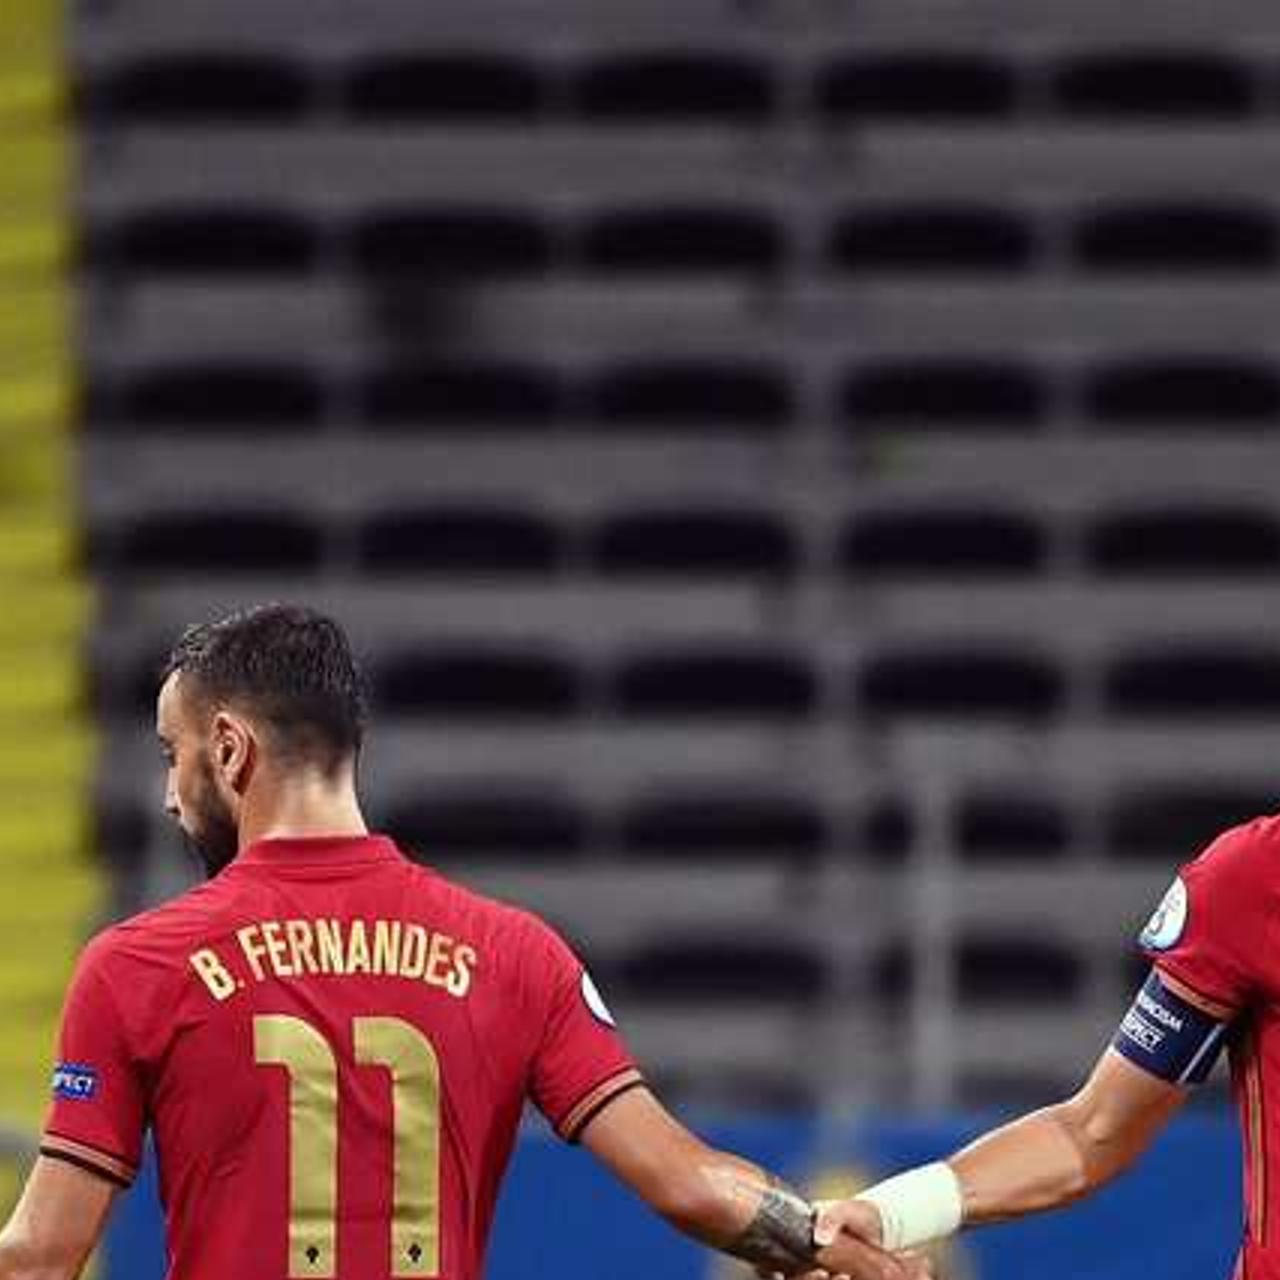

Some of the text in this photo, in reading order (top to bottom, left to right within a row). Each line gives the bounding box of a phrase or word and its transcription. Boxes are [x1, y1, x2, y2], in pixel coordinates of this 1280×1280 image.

[189, 919, 476, 1000] B. FERNANDES
[253, 1013, 440, 1279] 11
